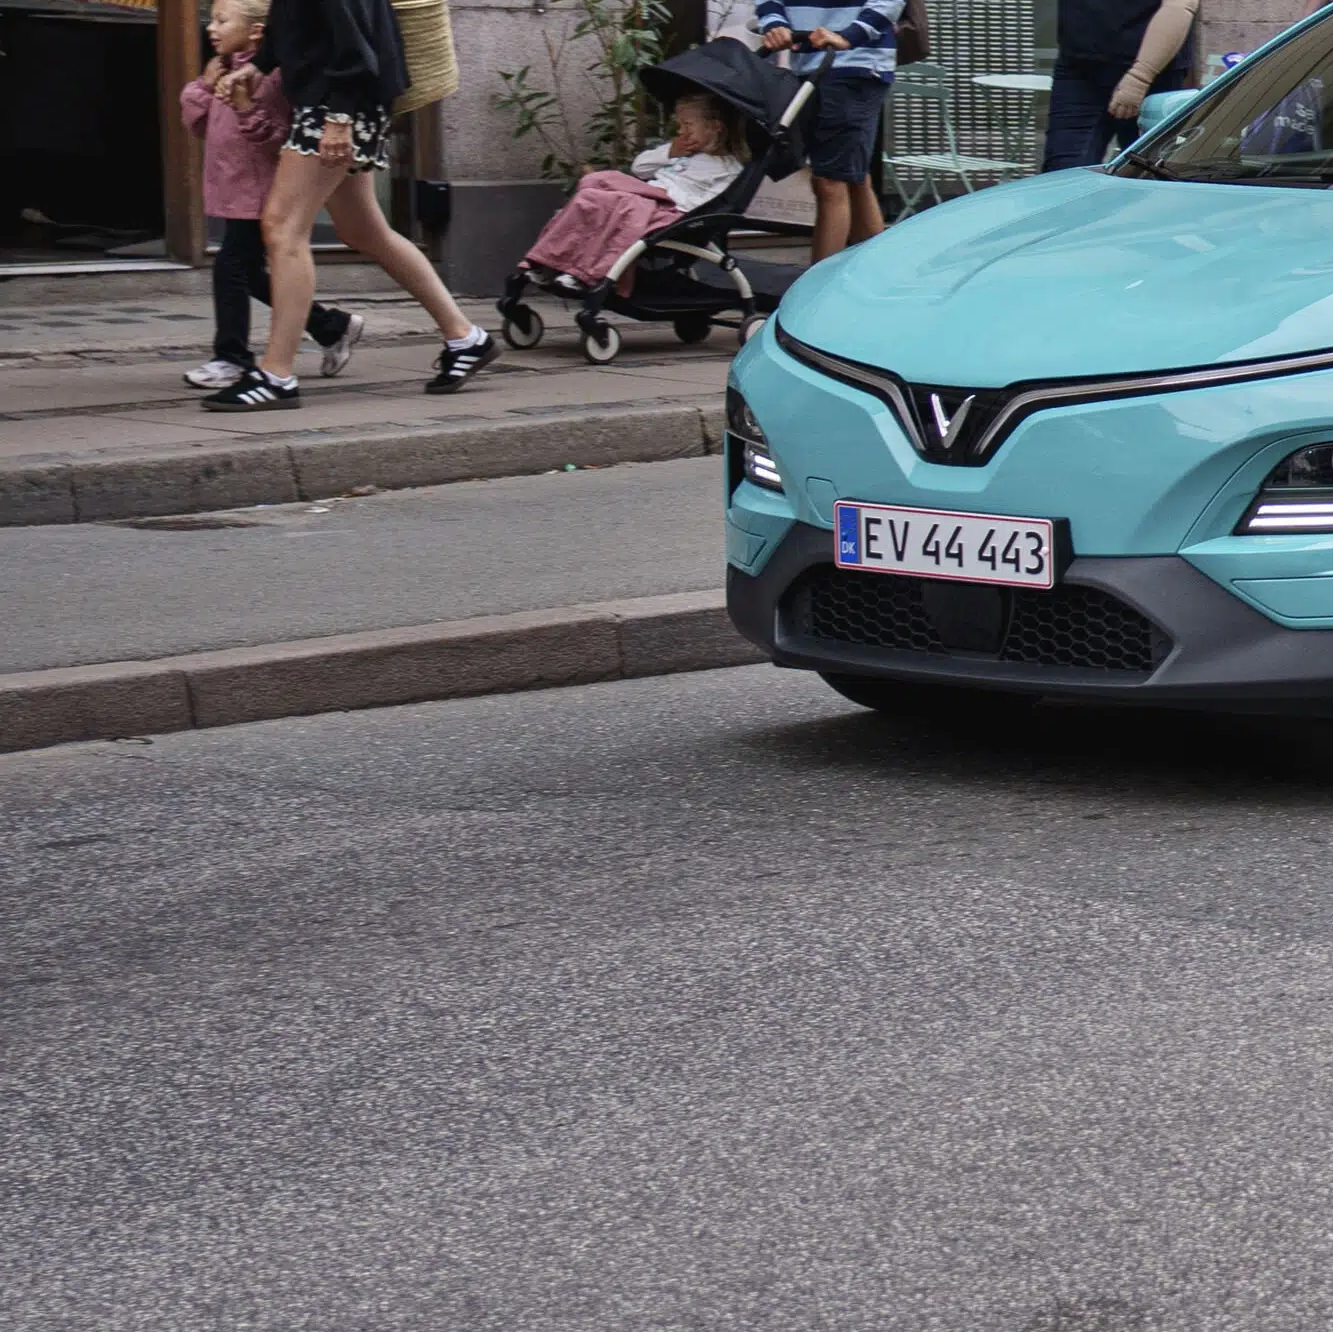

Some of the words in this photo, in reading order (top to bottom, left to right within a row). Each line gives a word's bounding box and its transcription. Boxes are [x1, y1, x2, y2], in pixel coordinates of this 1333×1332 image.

[841, 541, 856, 555] DK
[864, 517, 910, 562] EV
[922, 523, 963, 567] 44
[978, 529, 1045, 575] 443
